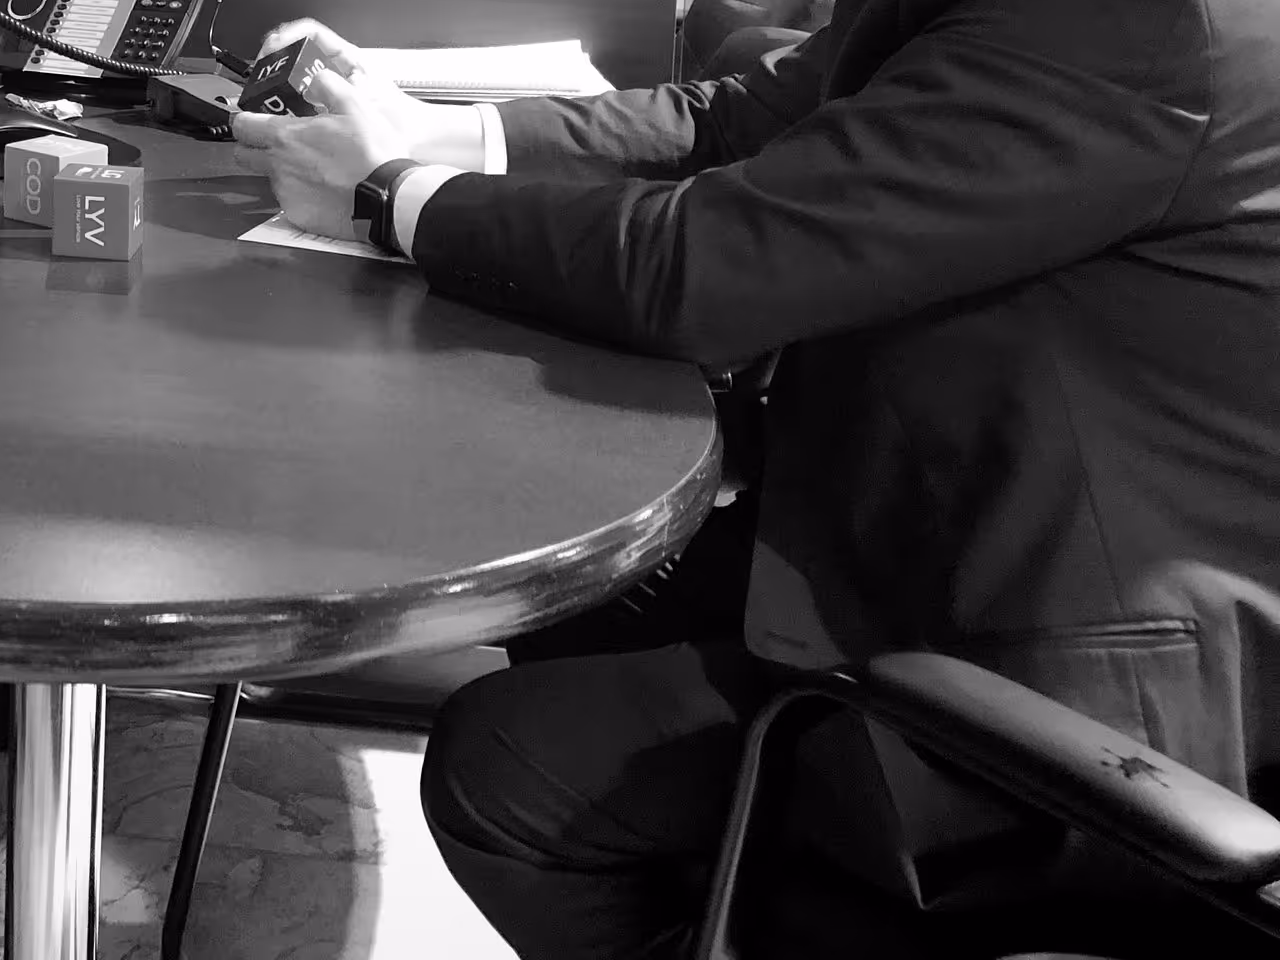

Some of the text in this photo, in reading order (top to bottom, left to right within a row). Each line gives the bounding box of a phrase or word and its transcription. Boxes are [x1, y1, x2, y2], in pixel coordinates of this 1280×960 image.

[257, 55, 290, 81] IYF
[26, 157, 41, 215] COD
[84, 195, 105, 247] LYV
